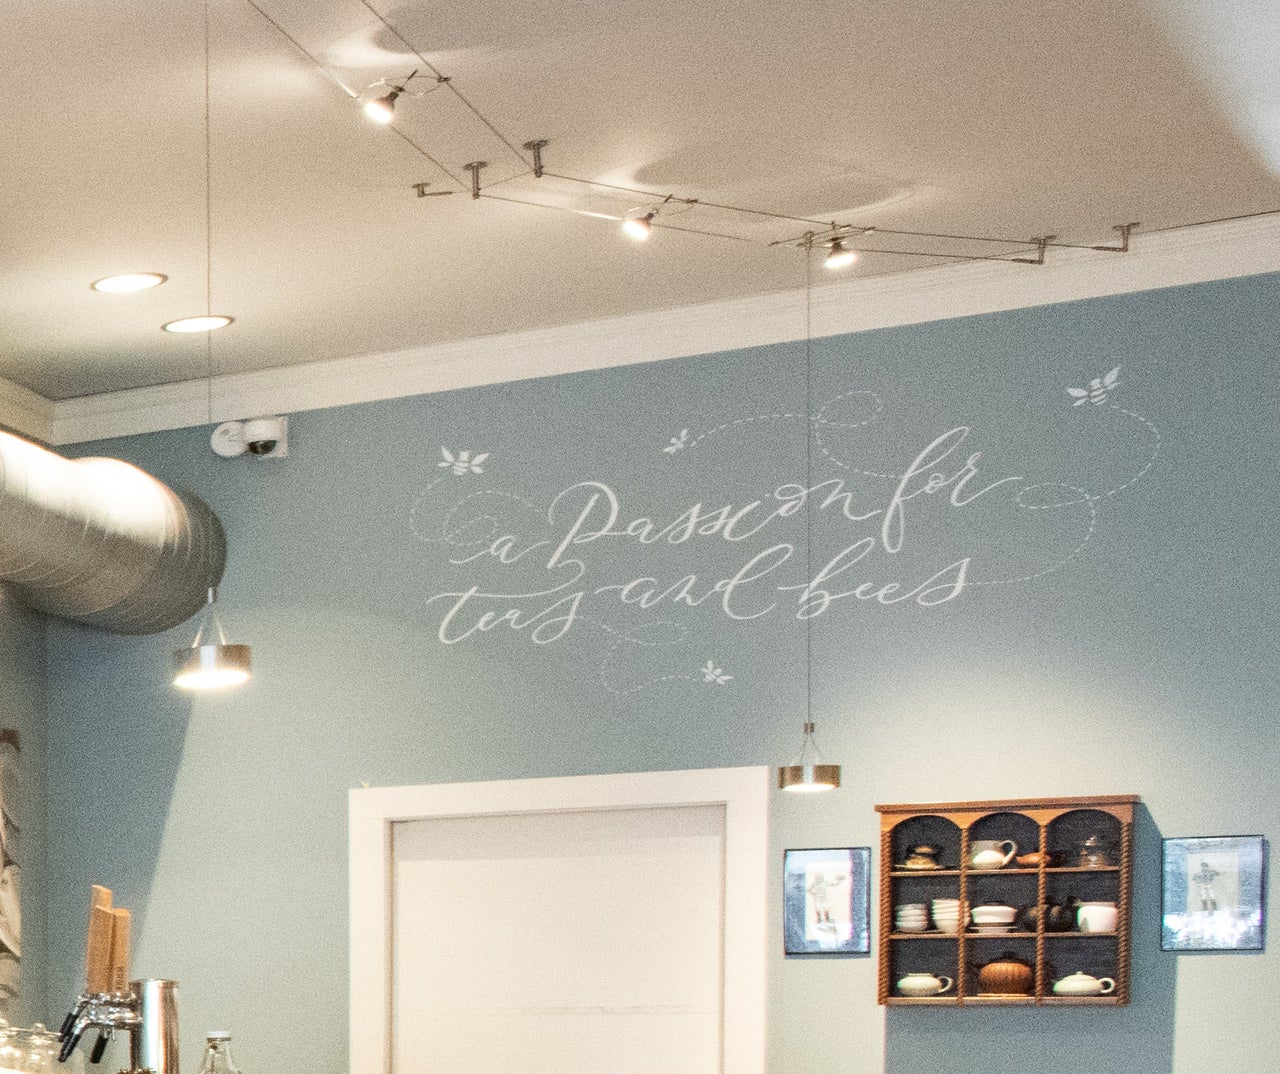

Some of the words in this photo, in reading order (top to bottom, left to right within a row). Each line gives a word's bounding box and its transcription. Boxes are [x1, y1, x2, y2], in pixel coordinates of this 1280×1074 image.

[875, 425, 1023, 554] for
[428, 568, 586, 645] teas
[597, 545, 794, 620] and
[778, 538, 973, 620] bees
